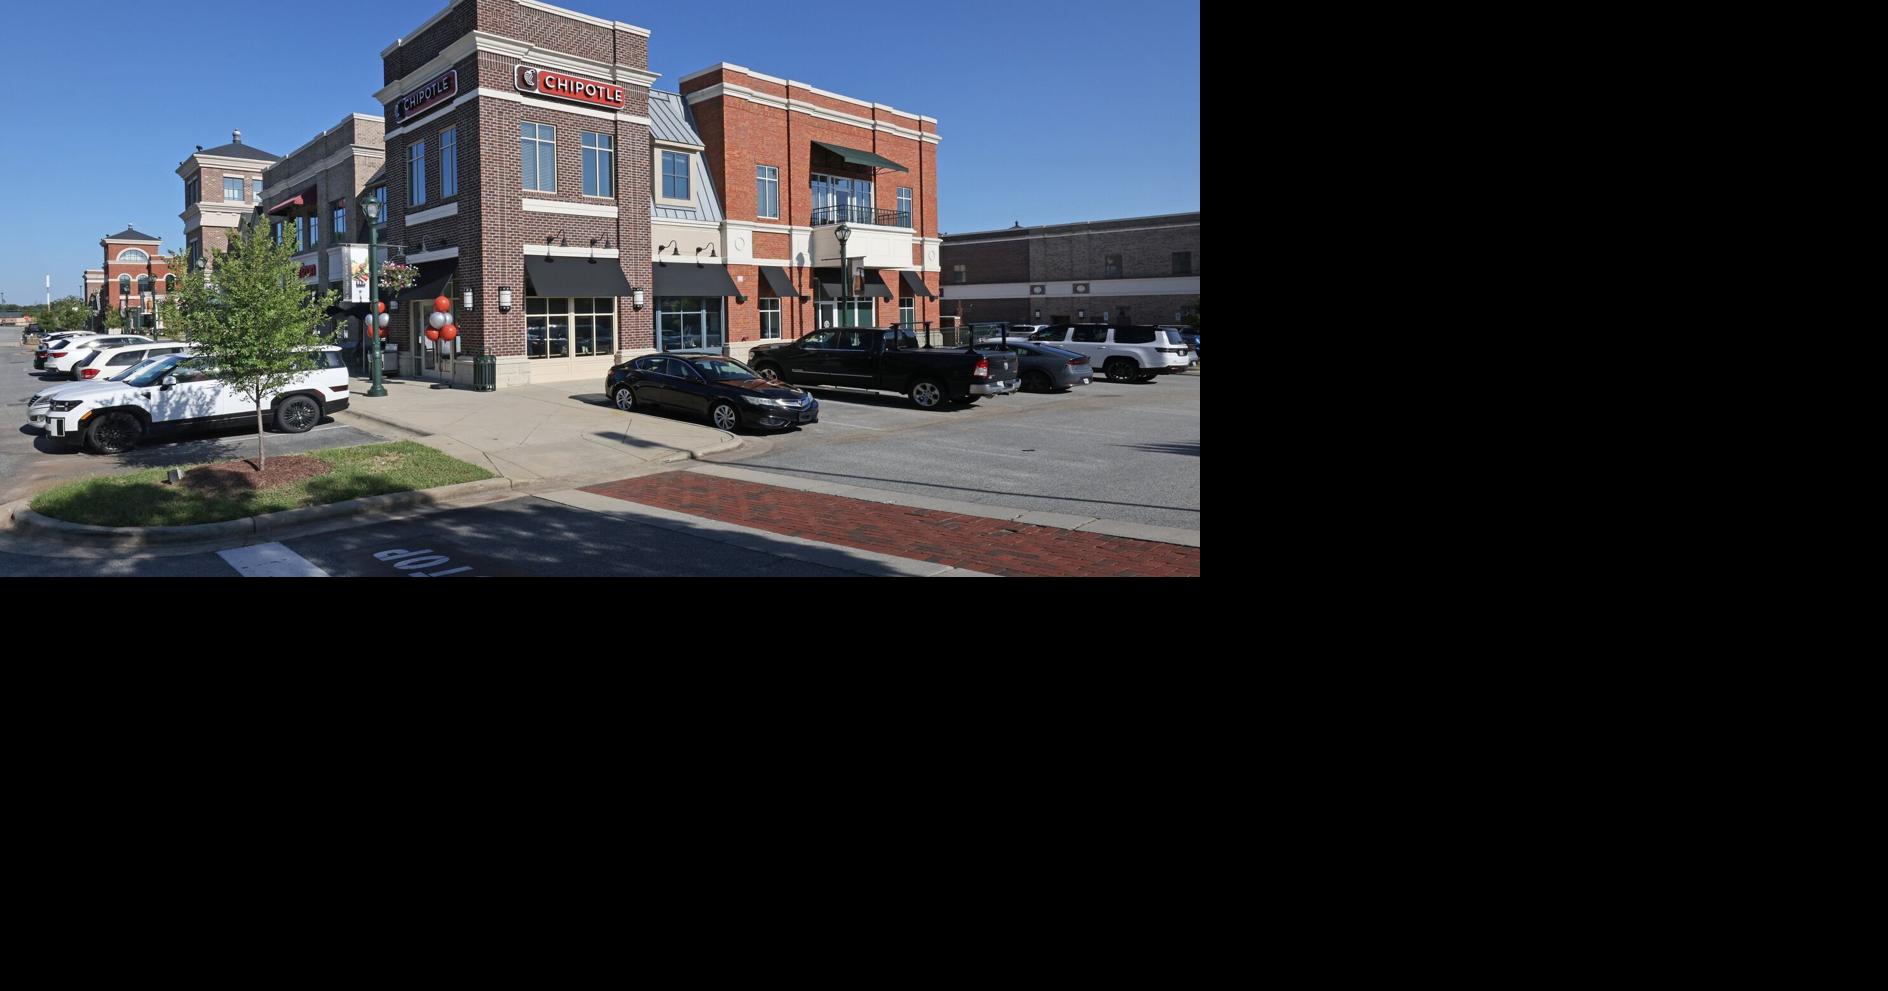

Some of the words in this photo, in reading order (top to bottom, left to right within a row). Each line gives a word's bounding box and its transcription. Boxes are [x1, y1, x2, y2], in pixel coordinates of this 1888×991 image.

[403, 77, 449, 111] CHIPOTLE
[545, 76, 622, 101] CHIPOTLE
[373, 549, 476, 577] TOP
